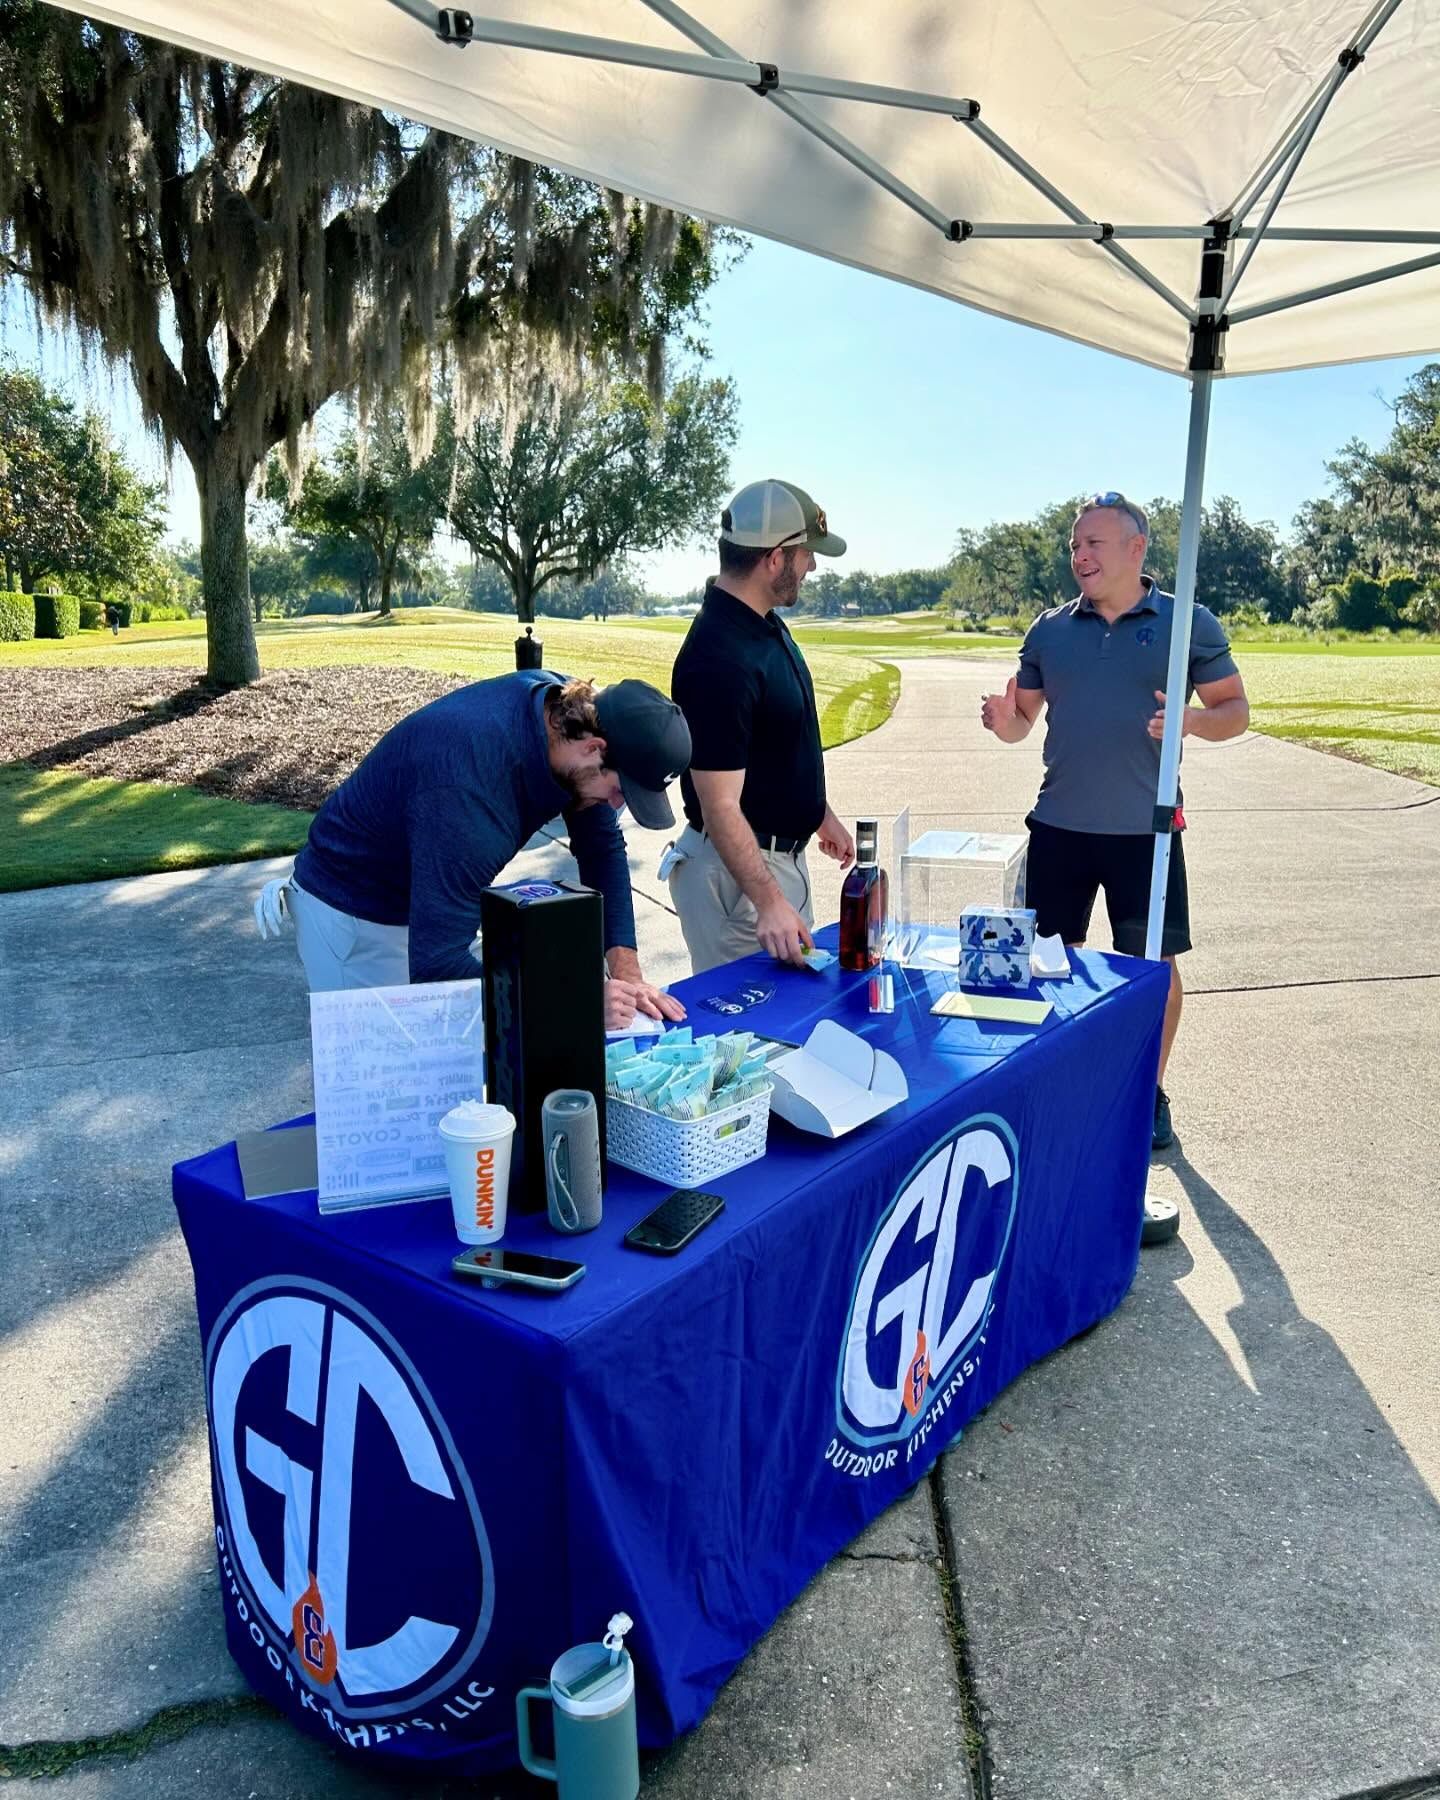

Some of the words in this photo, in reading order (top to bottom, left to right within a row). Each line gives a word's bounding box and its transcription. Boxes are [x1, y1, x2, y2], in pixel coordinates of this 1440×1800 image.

[475, 1148, 495, 1229] DUNKIN'
[825, 1438, 898, 1477] OUTDOOR
[216, 1525, 294, 1692] OUTDOOR
[443, 1681, 495, 1719] LLC
